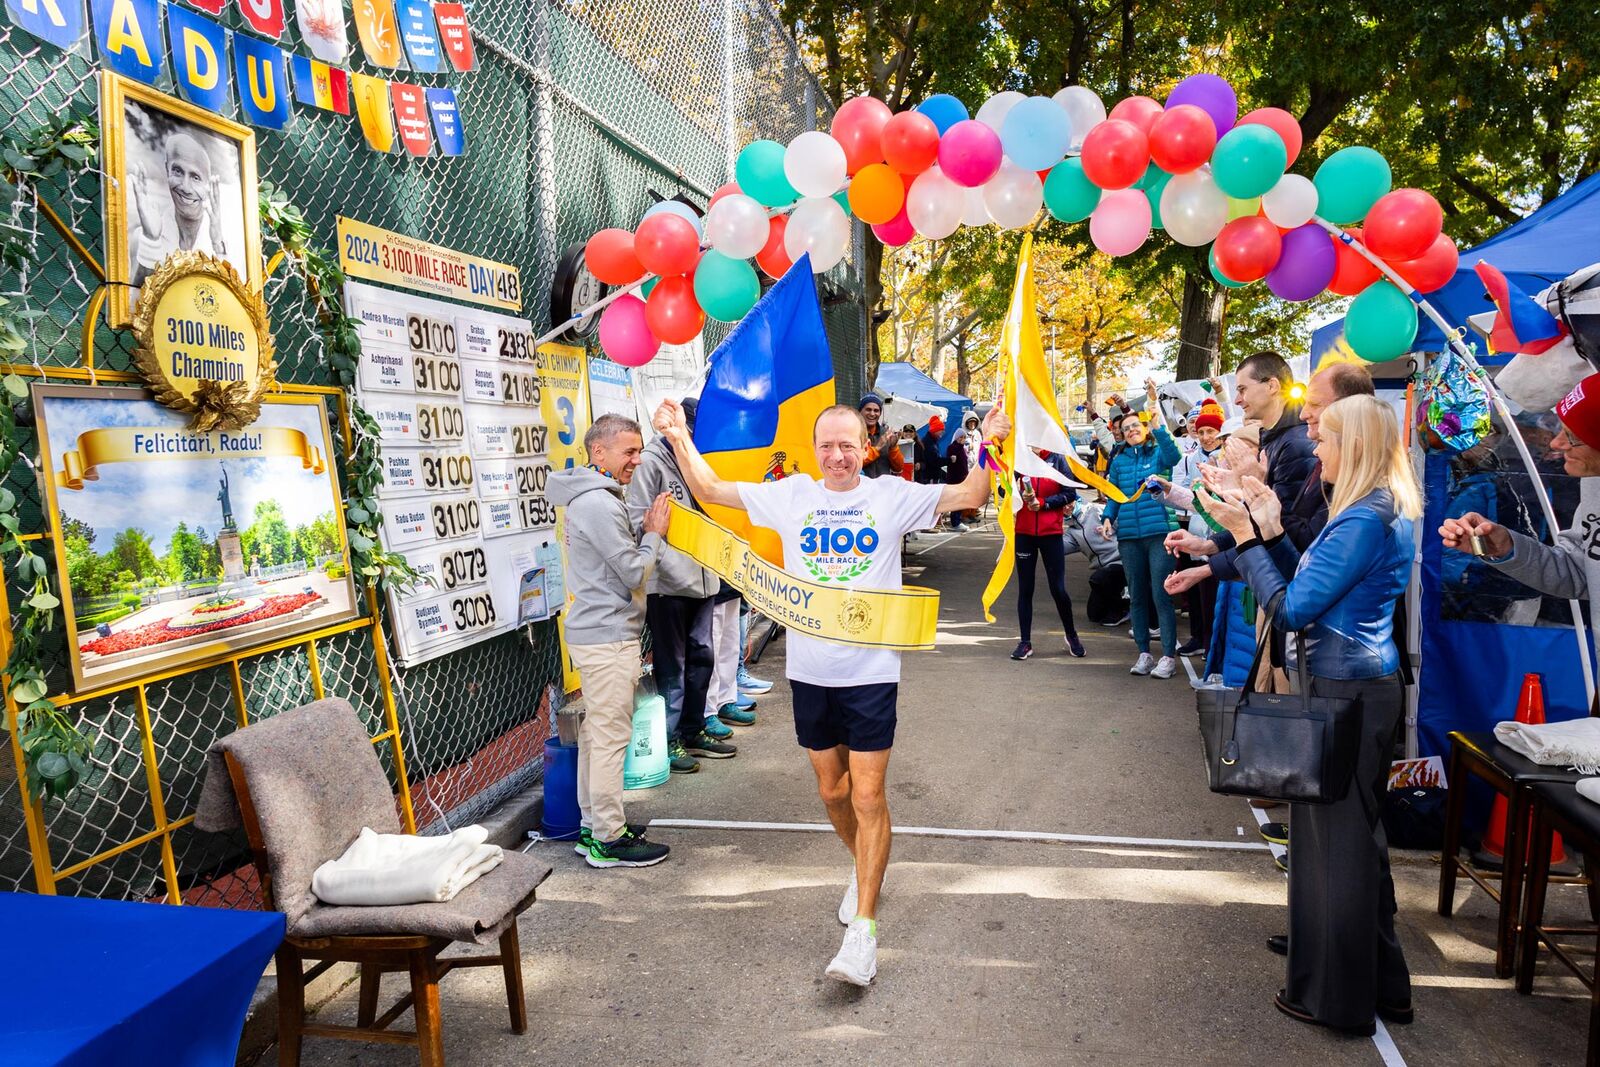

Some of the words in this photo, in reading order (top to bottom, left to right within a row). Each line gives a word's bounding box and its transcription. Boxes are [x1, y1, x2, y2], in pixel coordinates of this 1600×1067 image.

[394, 237, 416, 251] Chinmoy
[346, 234, 379, 266] 2024
[382, 244, 412, 274] 3,100
[414, 253, 440, 281] MILE
[441, 261, 467, 288] RACE
[469, 264, 494, 298] DAY
[497, 272, 518, 300] 48
[362, 310, 382, 324] Andrea
[382, 314, 405, 327] Marcato
[168, 318, 204, 347] 3100
[209, 323, 245, 352] Miles
[409, 316, 456, 354] 3100
[172, 351, 244, 382] Champion
[414, 357, 461, 392] 3100
[536, 352, 550, 371] SRI
[502, 373, 540, 404] 2185
[386, 411, 412, 422] Wei-Ming
[420, 406, 464, 439] 3100
[135, 433, 214, 454] Felicitări,
[220, 433, 262, 451] Radu!
[513, 426, 548, 454] 2167
[389, 457, 410, 466] Pushkar
[423, 456, 473, 488] 3100
[434, 500, 480, 538] 3100
[520, 498, 556, 528] 1593
[800, 527, 879, 555] 3100
[443, 548, 487, 588] 3079
[750, 564, 814, 609] CHINMOY
[789, 610, 822, 630] RACES
